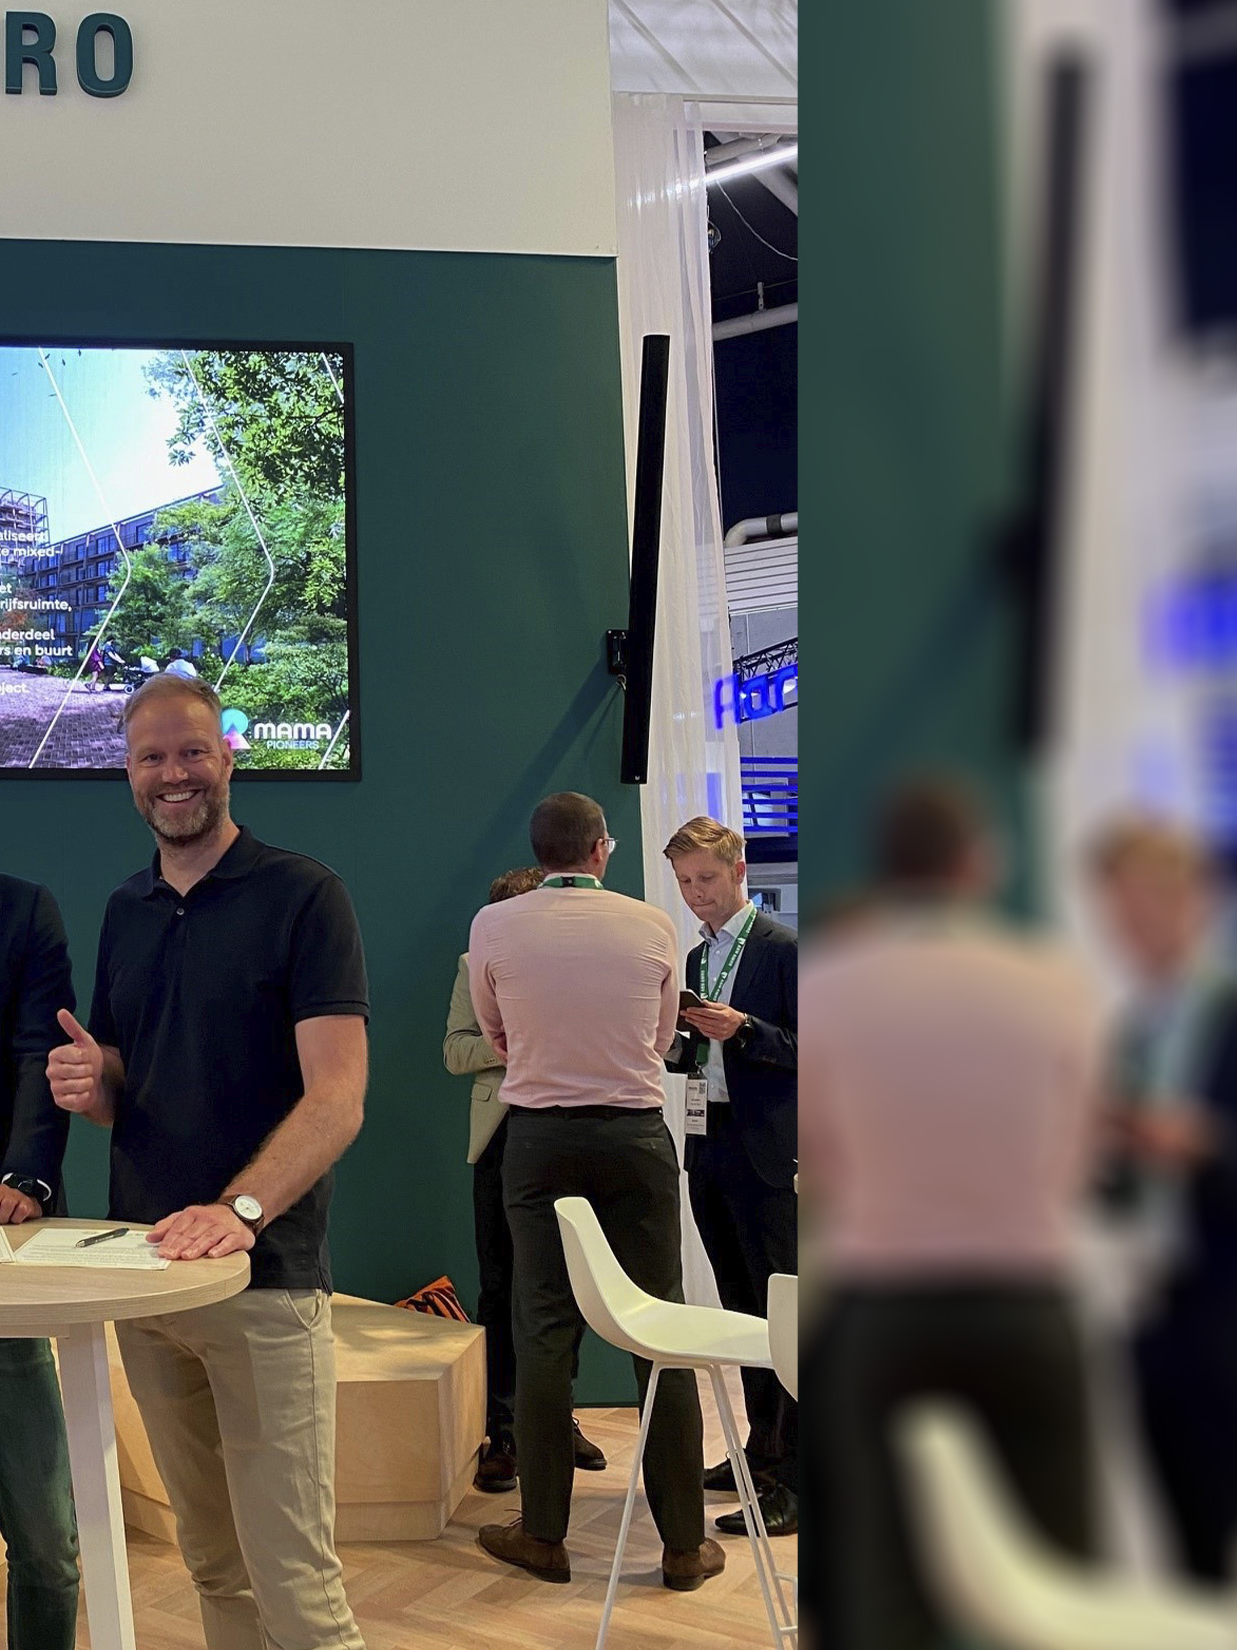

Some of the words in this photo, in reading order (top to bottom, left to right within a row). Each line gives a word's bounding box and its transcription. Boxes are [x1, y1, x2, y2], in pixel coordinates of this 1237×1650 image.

[13, 546, 60, 557] mixed-
[15, 647, 31, 656] en
[35, 645, 72, 656] buurt
[254, 722, 332, 740] MAMA
[266, 740, 320, 750] PIONEERS
